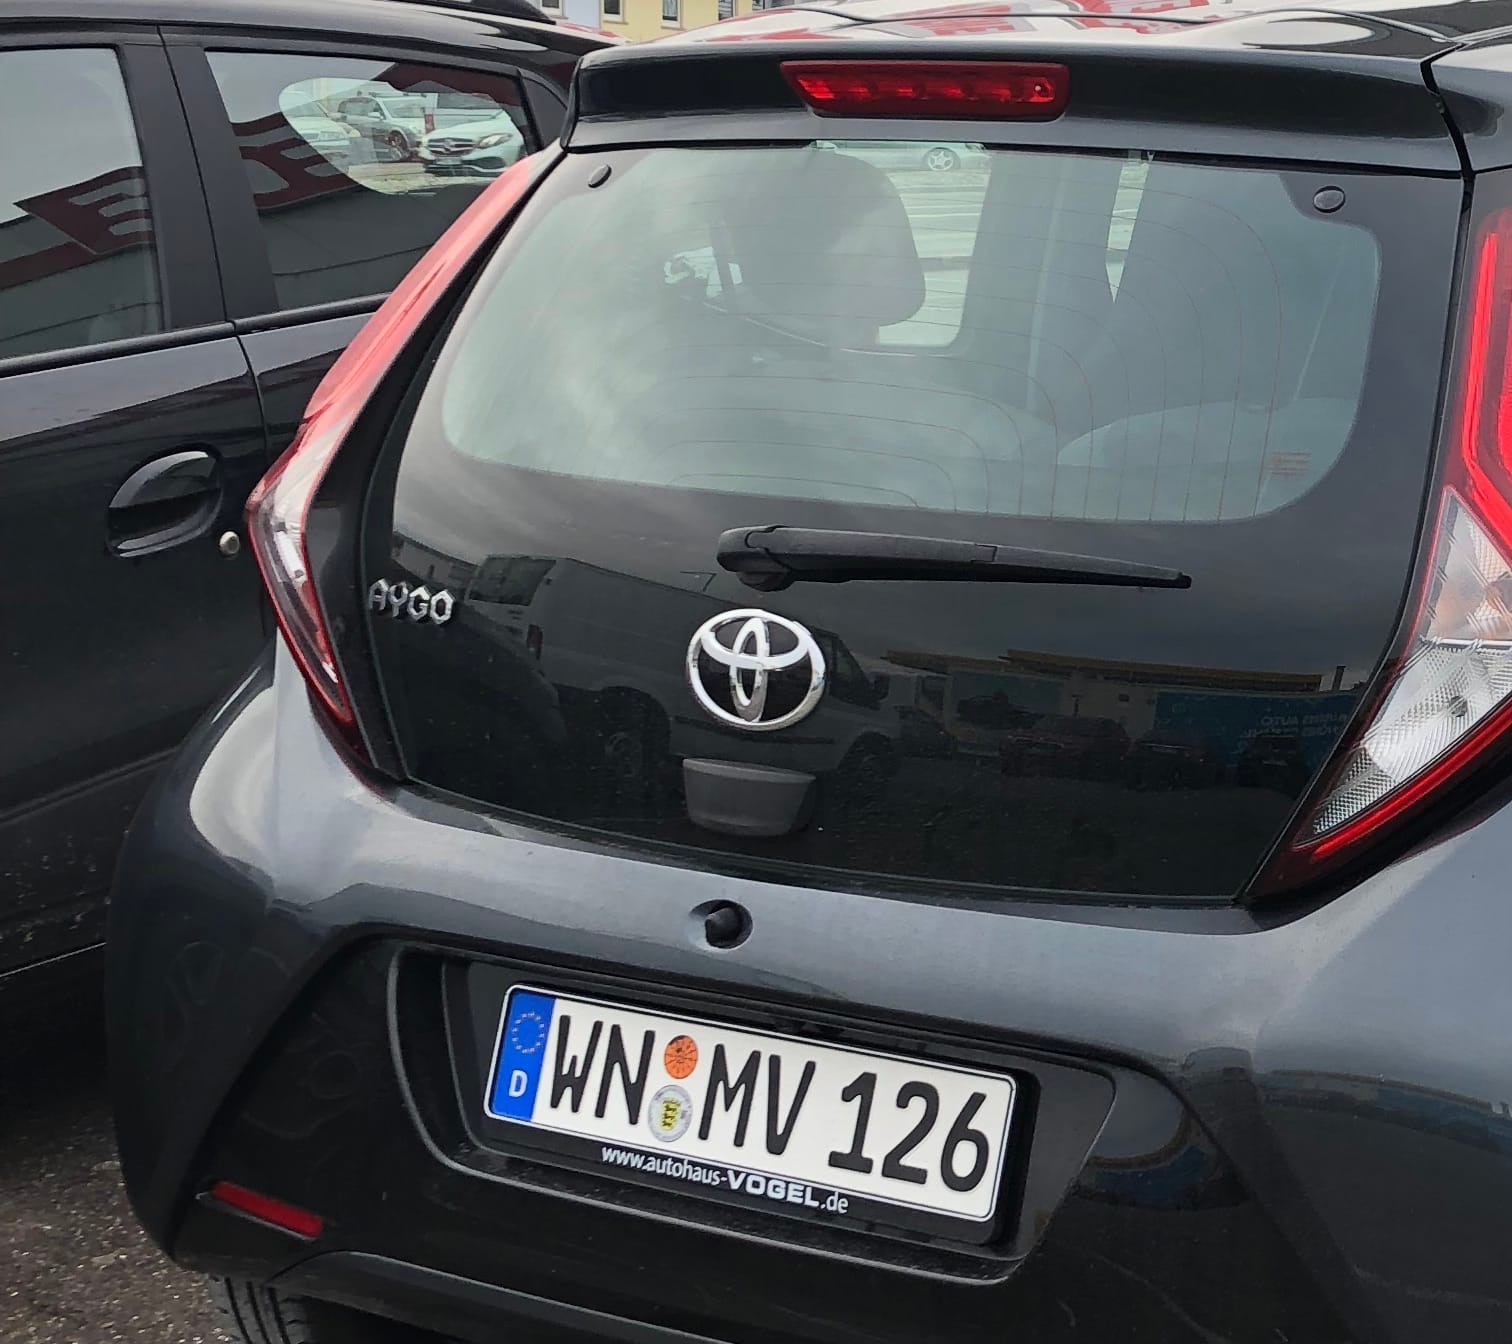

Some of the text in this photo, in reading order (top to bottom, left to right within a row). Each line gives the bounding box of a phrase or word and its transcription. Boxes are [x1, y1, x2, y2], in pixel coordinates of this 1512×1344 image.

[368, 578, 456, 625] AYGO
[508, 1069, 528, 1097] D
[550, 1014, 990, 1193] WN MV 126
[601, 1146, 850, 1214] www.autohaus-VOGEL.de
